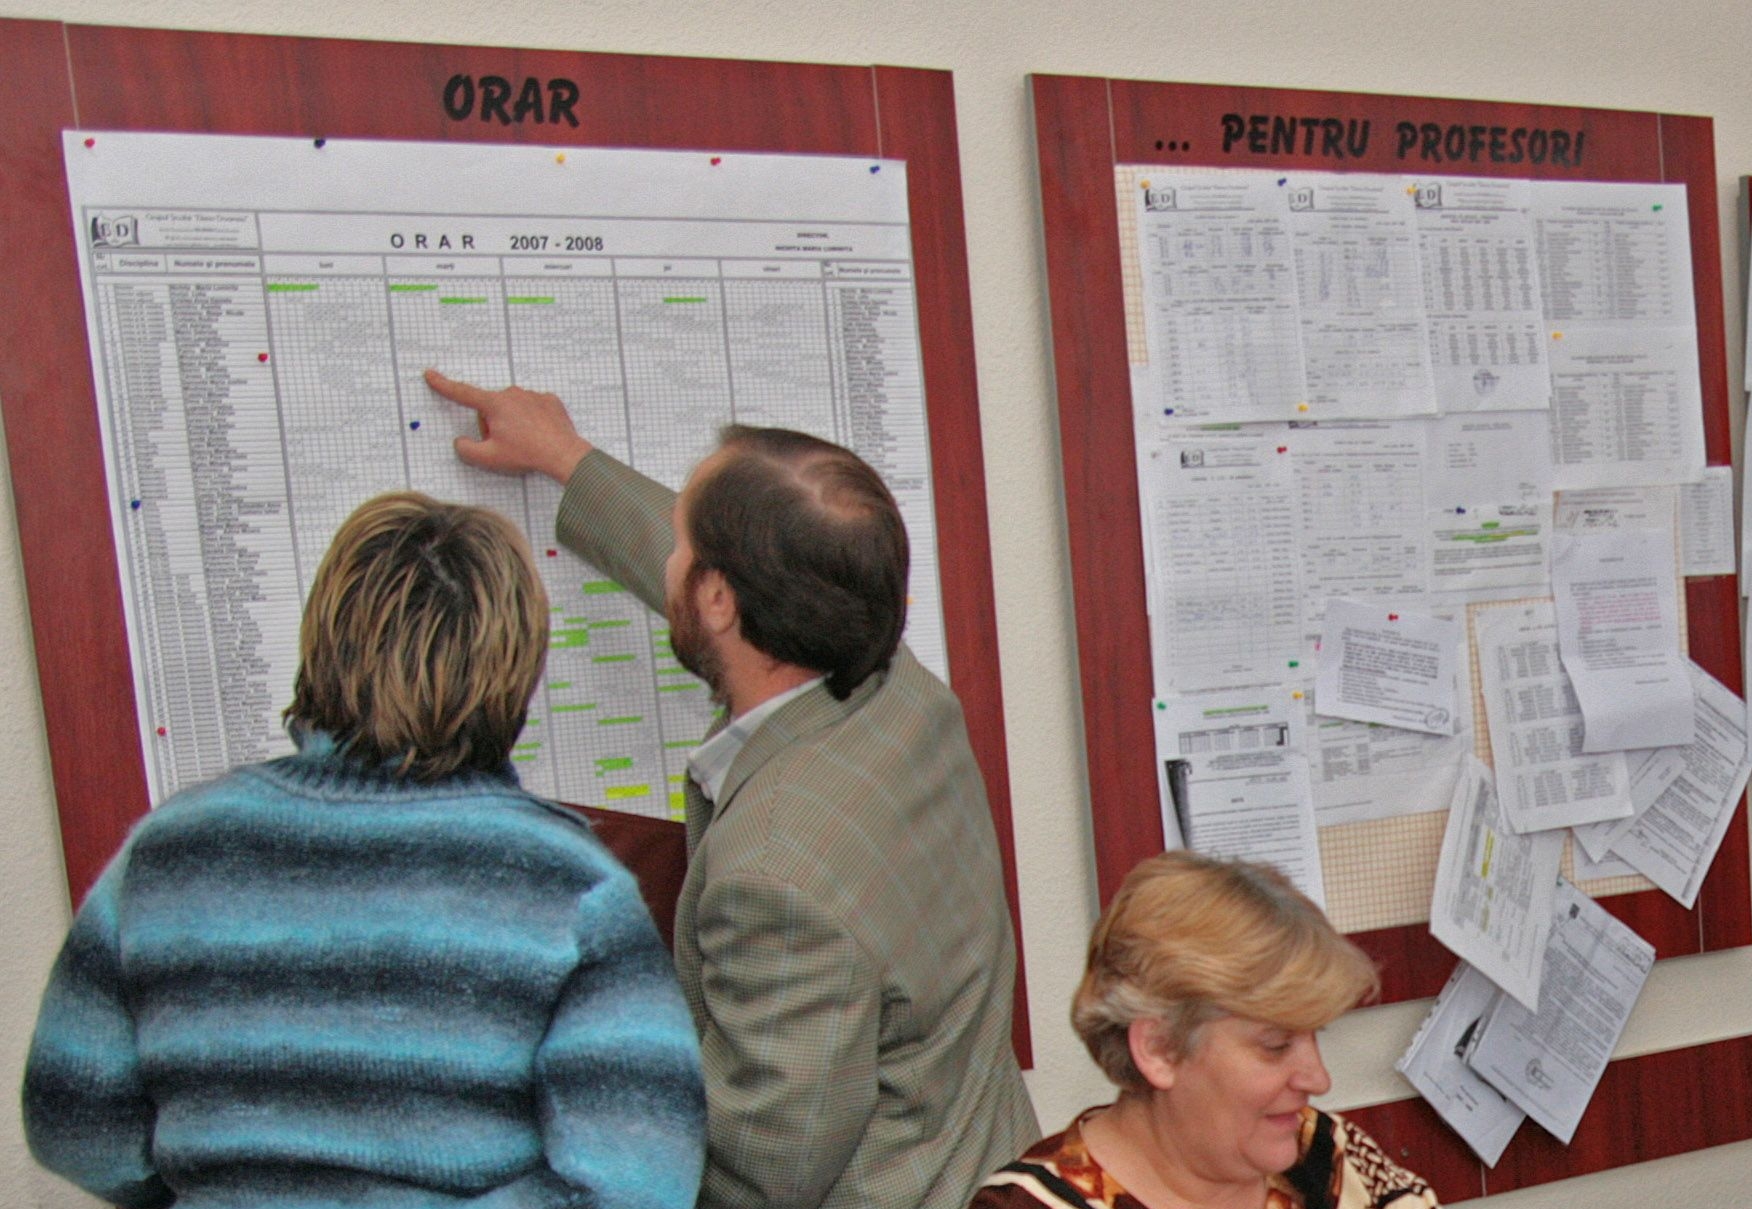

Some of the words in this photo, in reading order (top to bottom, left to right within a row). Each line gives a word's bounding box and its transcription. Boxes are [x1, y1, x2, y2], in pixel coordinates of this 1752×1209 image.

[443, 73, 580, 128] ORAR
[1221, 113, 1370, 159] PENTRU
[1396, 121, 1585, 168] PROFESORI
[510, 236, 549, 251] 2007
[565, 236, 604, 252] 2008
